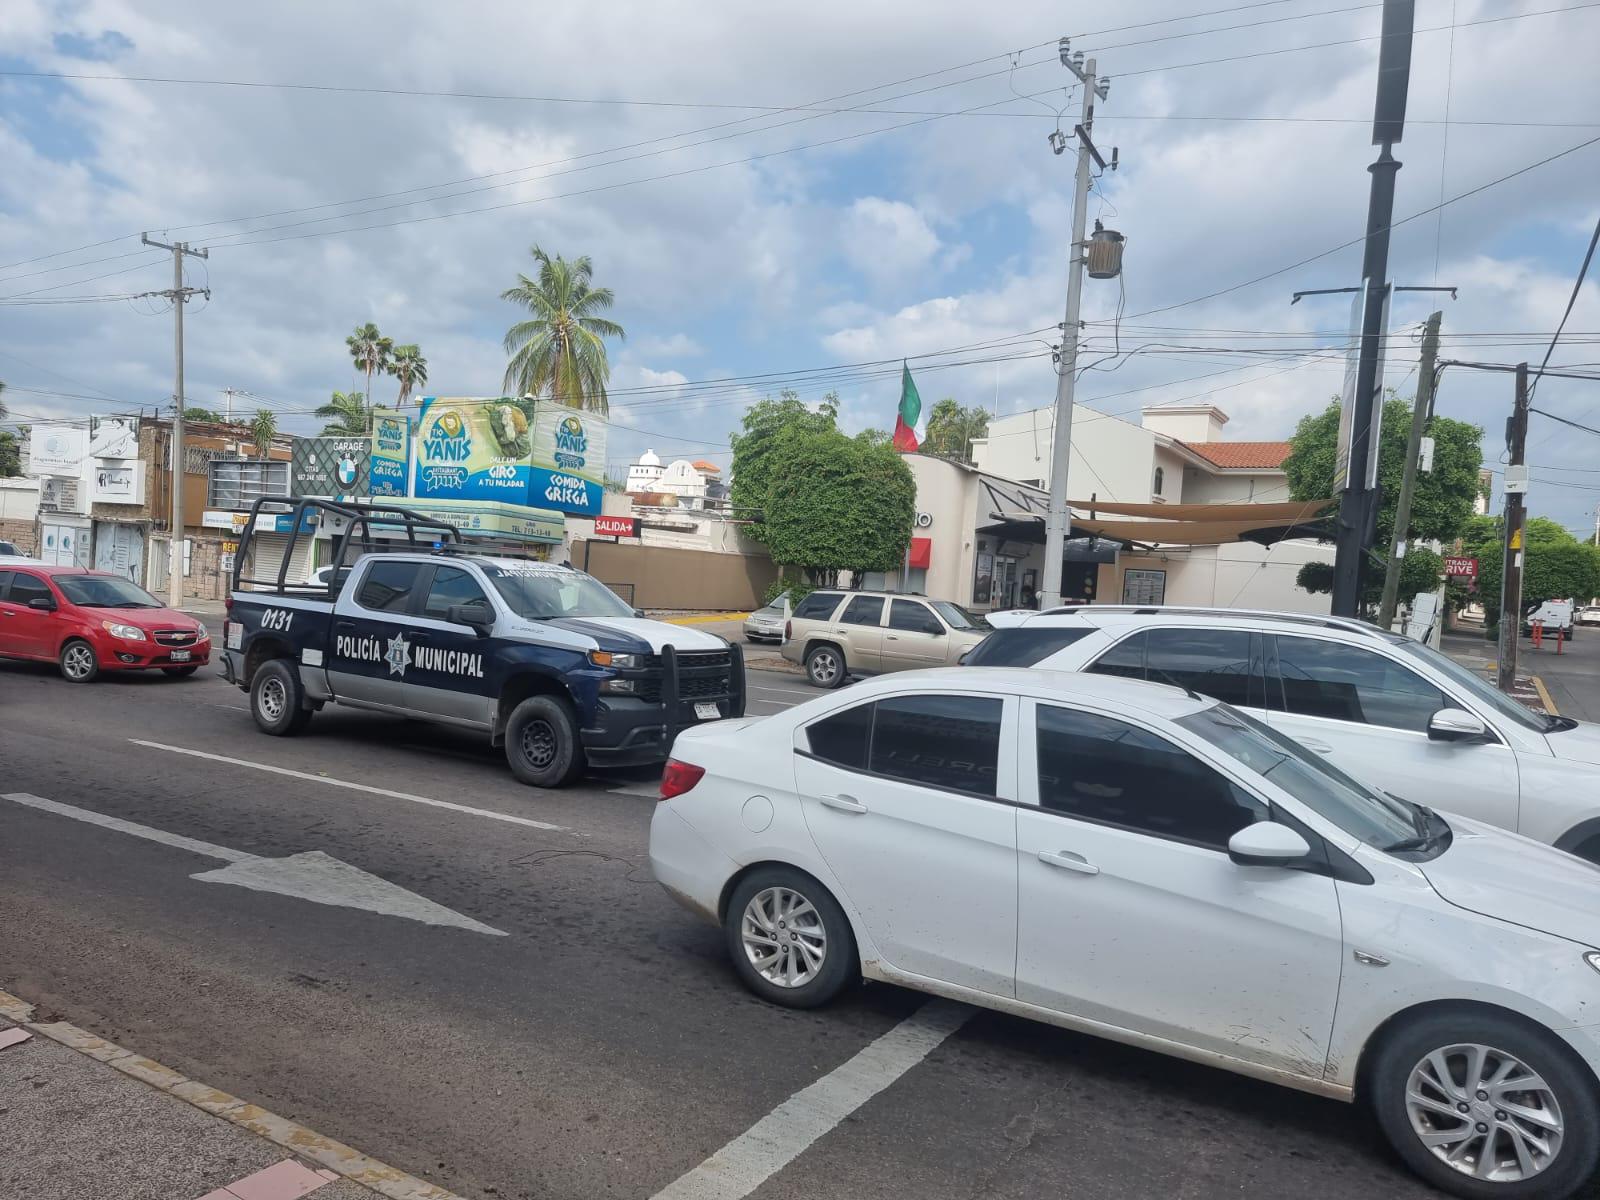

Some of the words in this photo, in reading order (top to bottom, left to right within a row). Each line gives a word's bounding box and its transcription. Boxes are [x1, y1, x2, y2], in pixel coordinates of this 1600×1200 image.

[377, 427, 403, 440] YANIS
[333, 441, 364, 451] GARAGE
[423, 439, 471, 460] YANIS
[555, 432, 587, 453] YANIS
[376, 459, 401, 469] COMIDA
[373, 466, 403, 478] GRIEGA
[489, 465, 517, 479] GIRO
[485, 479, 494, 487] TU
[495, 480, 525, 488] PALADAR
[550, 474, 586, 490] COMIDA
[544, 486, 589, 507] GRIEGA
[596, 520, 626, 532] SALIDA
[261, 608, 294, 632] 0131
[336, 634, 381, 662] POLICÍA
[415, 646, 484, 678] MUNICIPAL
